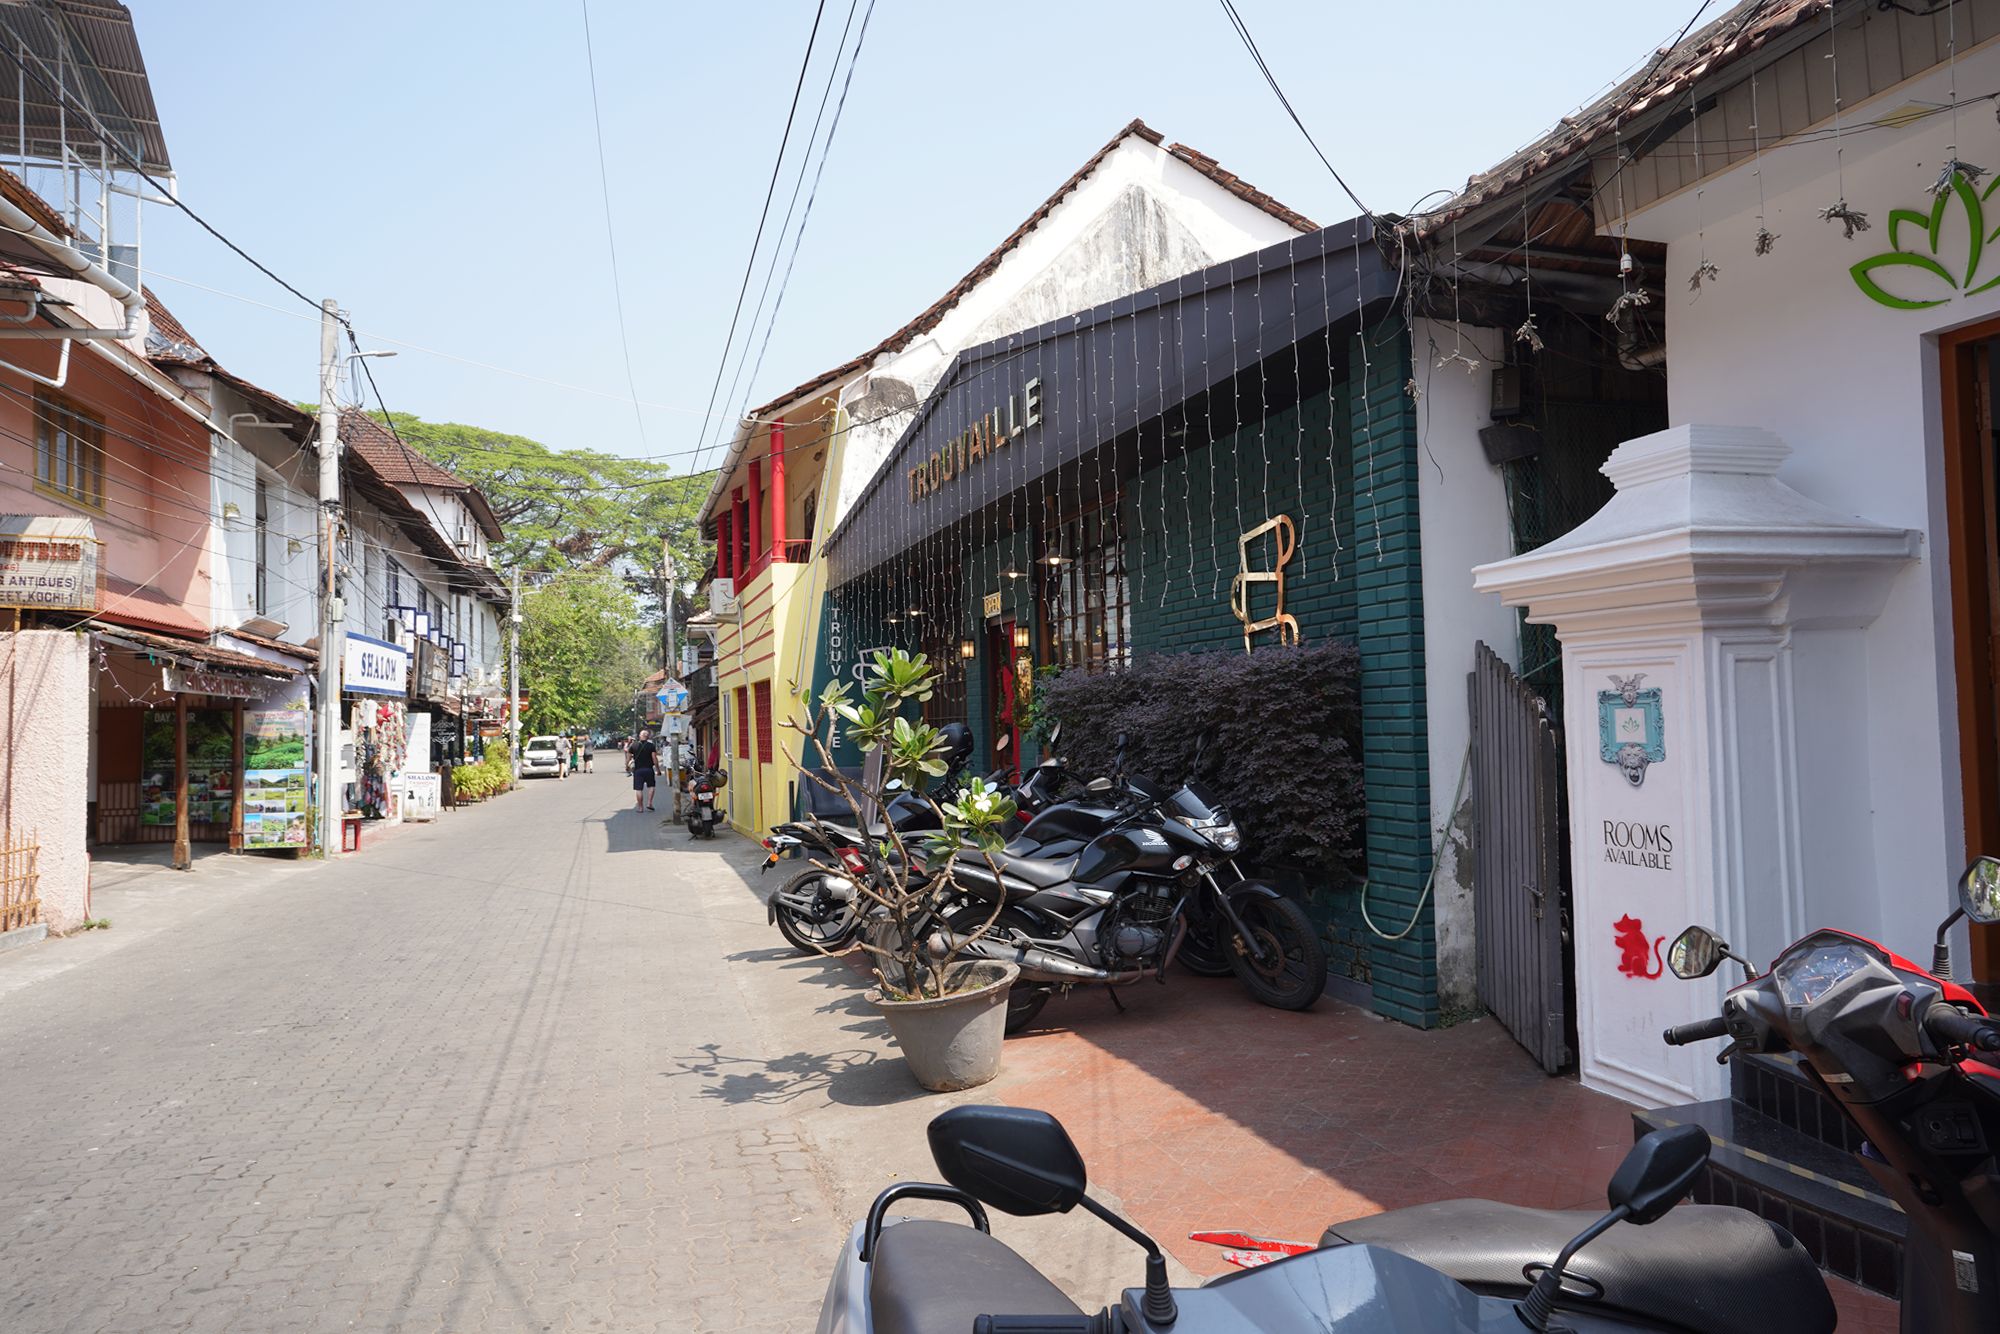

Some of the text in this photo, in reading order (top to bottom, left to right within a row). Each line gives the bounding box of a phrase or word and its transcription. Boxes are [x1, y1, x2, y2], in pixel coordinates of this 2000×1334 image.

[908, 376, 1041, 504] TROUVAILLE
[0, 541, 81, 561] USTRIES
[361, 652, 397, 681] SHALOM
[1603, 820, 1673, 853] ROOMS
[1604, 848, 1672, 870] AVAILABLE
